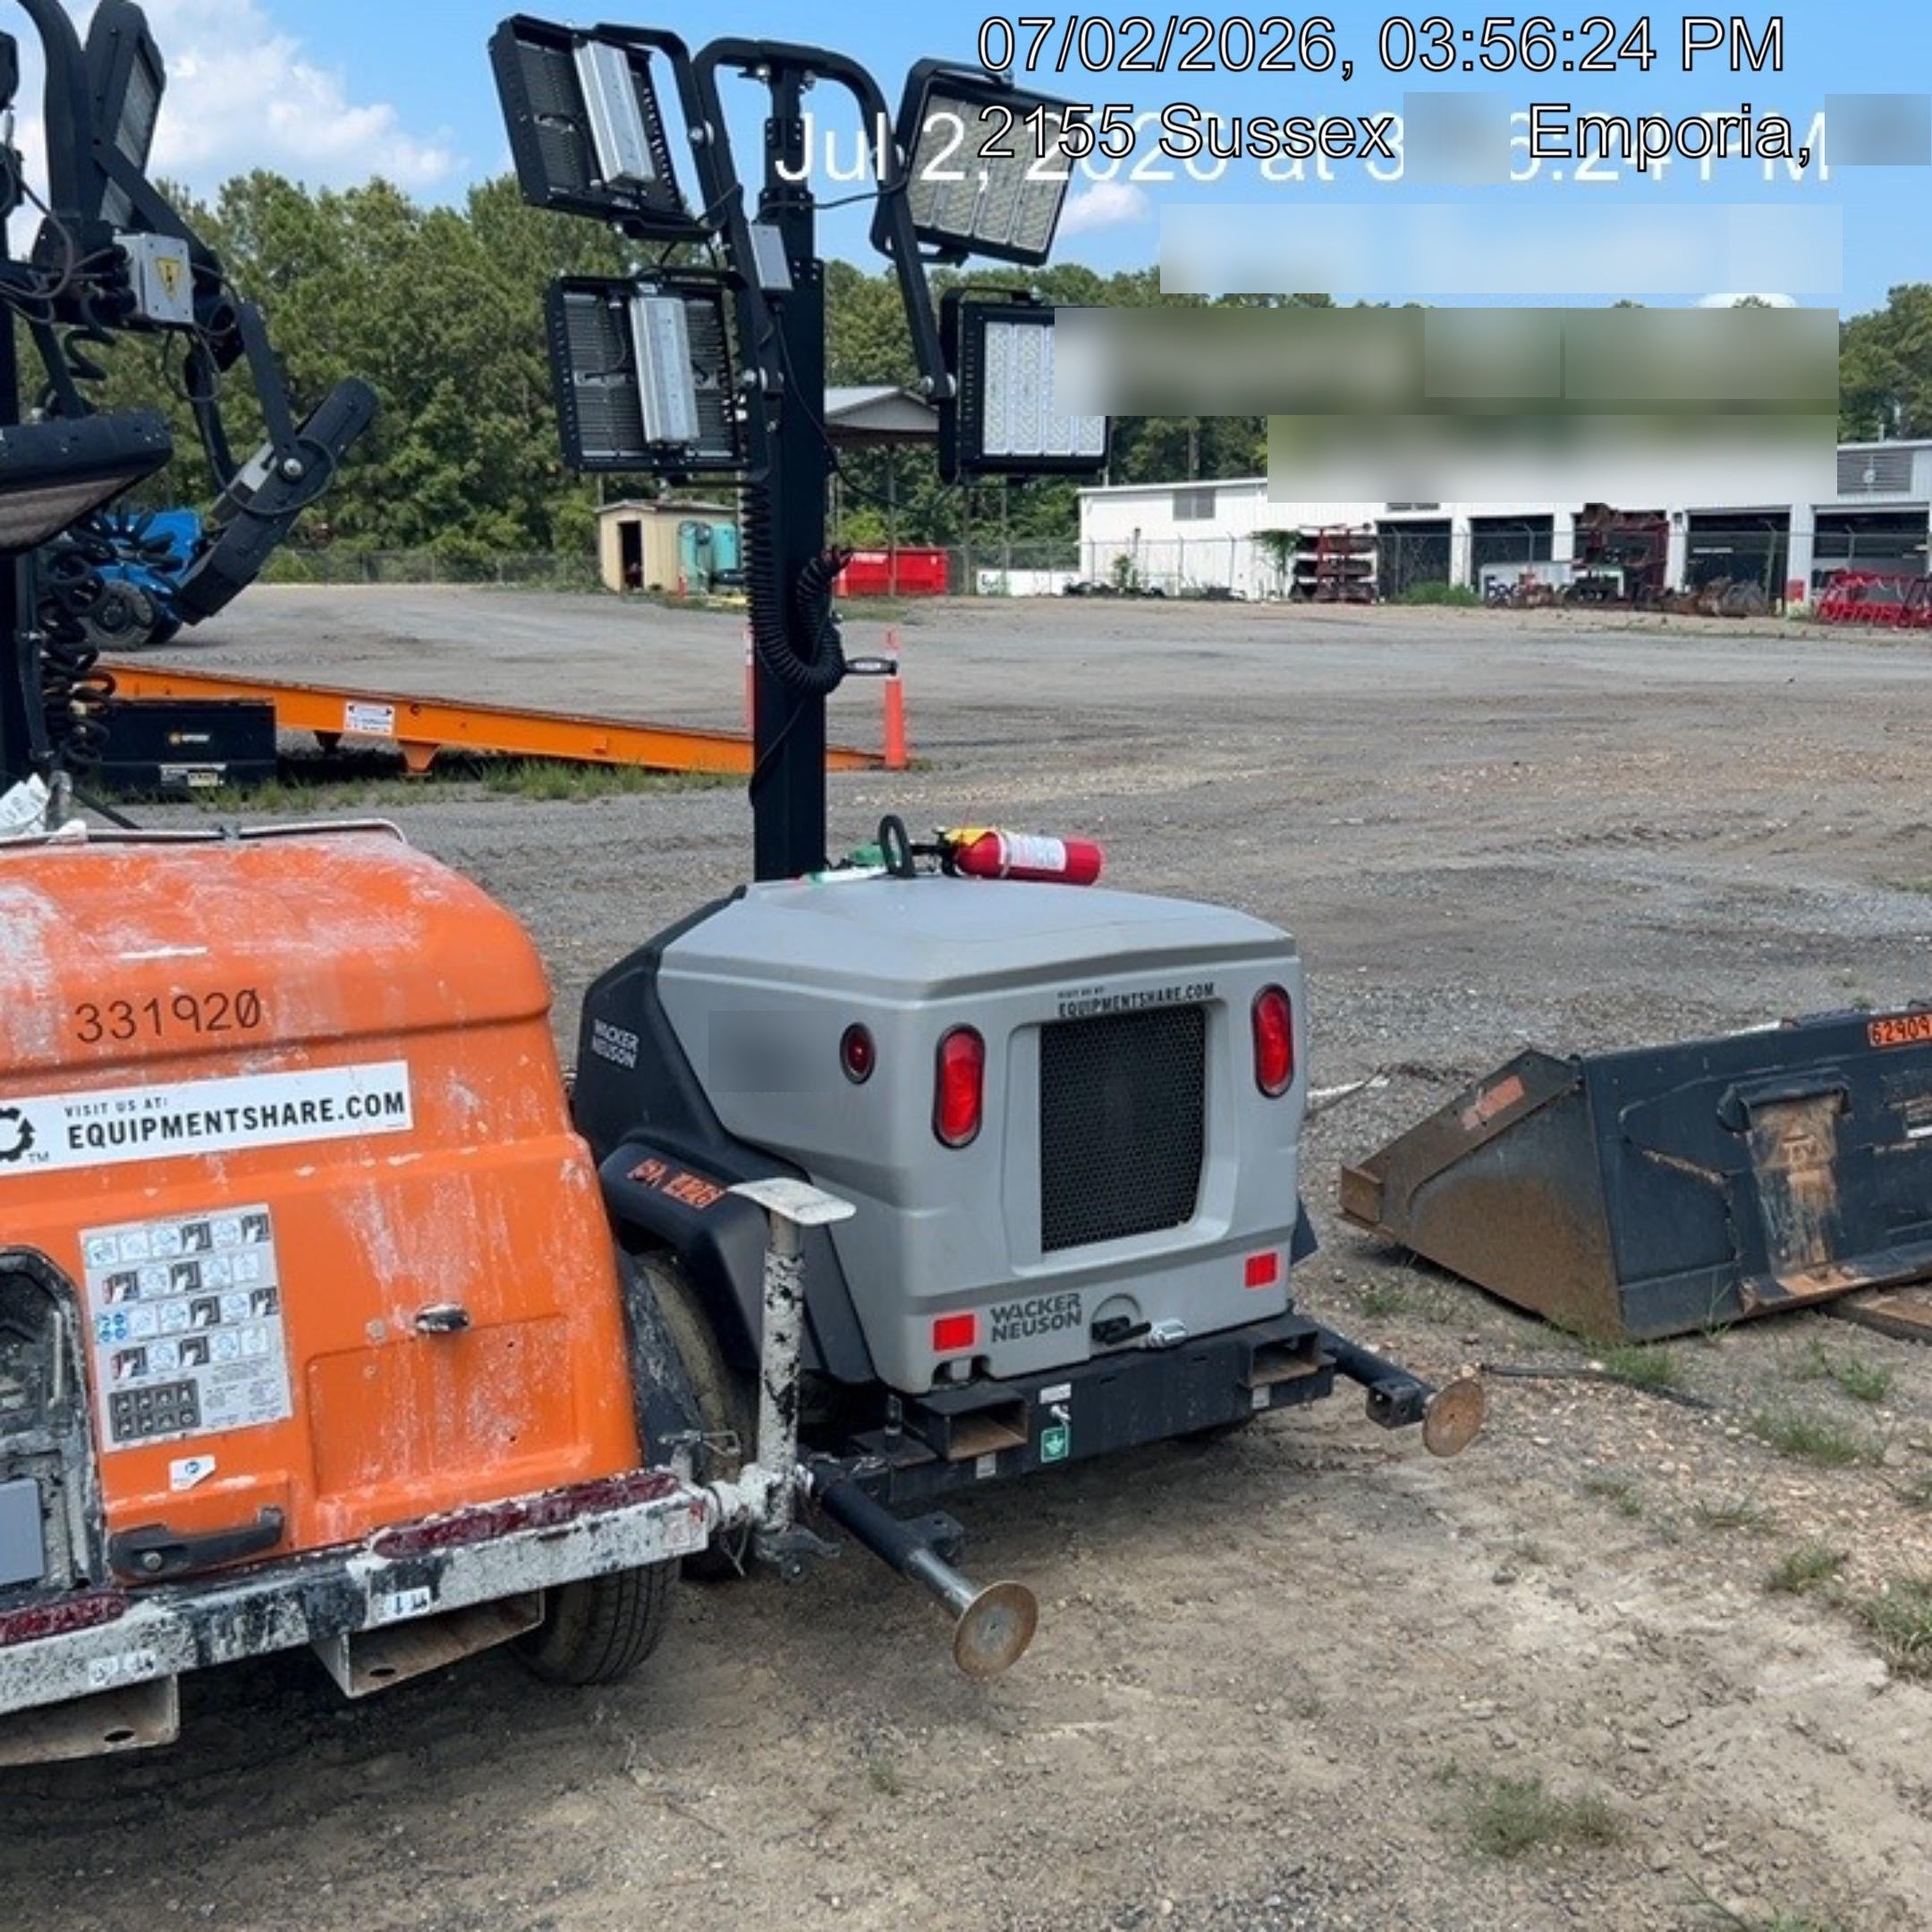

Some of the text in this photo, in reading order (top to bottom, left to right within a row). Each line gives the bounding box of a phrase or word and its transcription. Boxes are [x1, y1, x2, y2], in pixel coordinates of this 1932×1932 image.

[75, 988, 261, 1044] 331920
[64, 1102, 107, 1117] VISIT
[115, 1099, 136, 1113] US
[68, 1091, 406, 1149] EQUIPMENTSHARE.COM
[990, 1293, 1081, 1323] WACKER
[991, 1309, 1082, 1343] NEUSON
